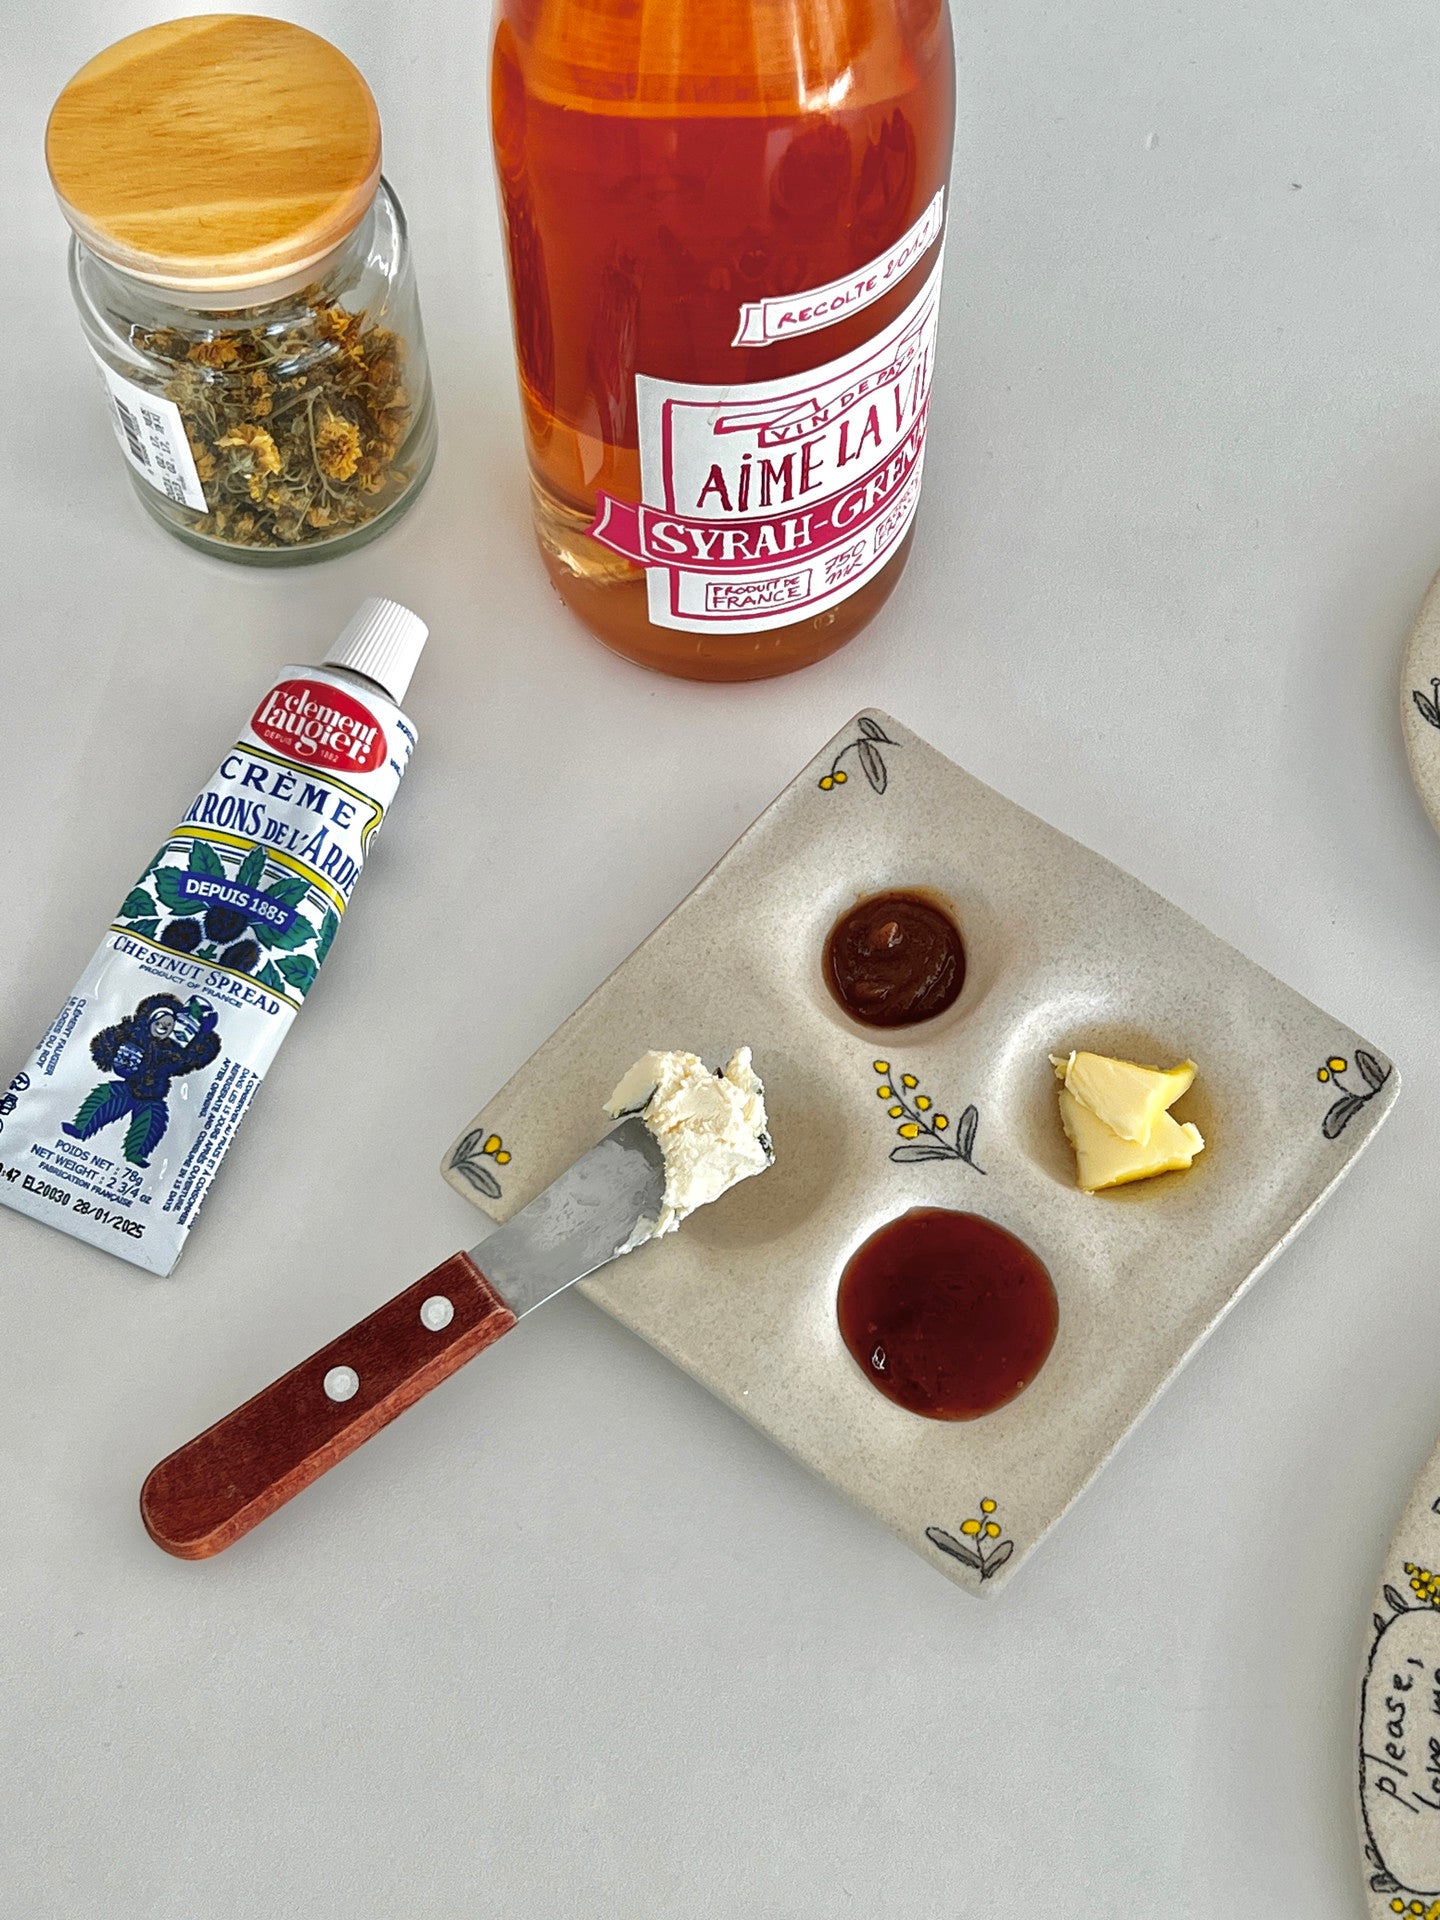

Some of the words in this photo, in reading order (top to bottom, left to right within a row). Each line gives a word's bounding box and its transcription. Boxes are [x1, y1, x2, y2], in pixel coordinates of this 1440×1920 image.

[778, 275, 877, 329] RECOLTE
[771, 409, 829, 440] VIN
[841, 380, 869, 407] DE
[876, 346, 915, 386] PAYS
[837, 404, 882, 467] LA
[825, 540, 867, 575] 750
[713, 578, 782, 596] PRODUIT
[784, 576, 800, 588] DE
[713, 586, 802, 609] FRANCE
[220, 755, 357, 830] CRÈME
[263, 817, 290, 846] DE
[185, 879, 251, 907] DEPUIS
[248, 898, 289, 925] 1885
[113, 935, 205, 980] CHESTNUT
[205, 971, 281, 1016] SPREAD
[138, 963, 184, 985] PRODUCT
[186, 980, 201, 990] OF
[201, 987, 244, 1009] FRANCE
[214, 1062, 241, 1113] REFRIGERATE
[215, 1057, 231, 1081] AFTER
[235, 1067, 250, 1090] DANS
[227, 1085, 238, 1102] LES
[229, 1080, 254, 1124] CONSERVER
[204, 1112, 216, 1131] AND
[210, 1114, 226, 1141] JOURS
[54, 1139, 91, 1161] POIDS
[90, 1155, 115, 1172] NET
[121, 1167, 144, 1187] 78g
[182, 1130, 207, 1168] CONSUME
[212, 1136, 228, 1159] FRAIS
[30, 1143, 55, 1161] NET
[55, 1154, 100, 1180] WEIGHT
[106, 1177, 118, 1190] 2
[117, 1182, 142, 1199] 3/4
[38, 1161, 92, 1190] FABRICATION
[73, 1199, 147, 1240] 28/01/2025
[162, 1190, 178, 1212] DAYS
[176, 1177, 206, 1226] CONSOMMER
